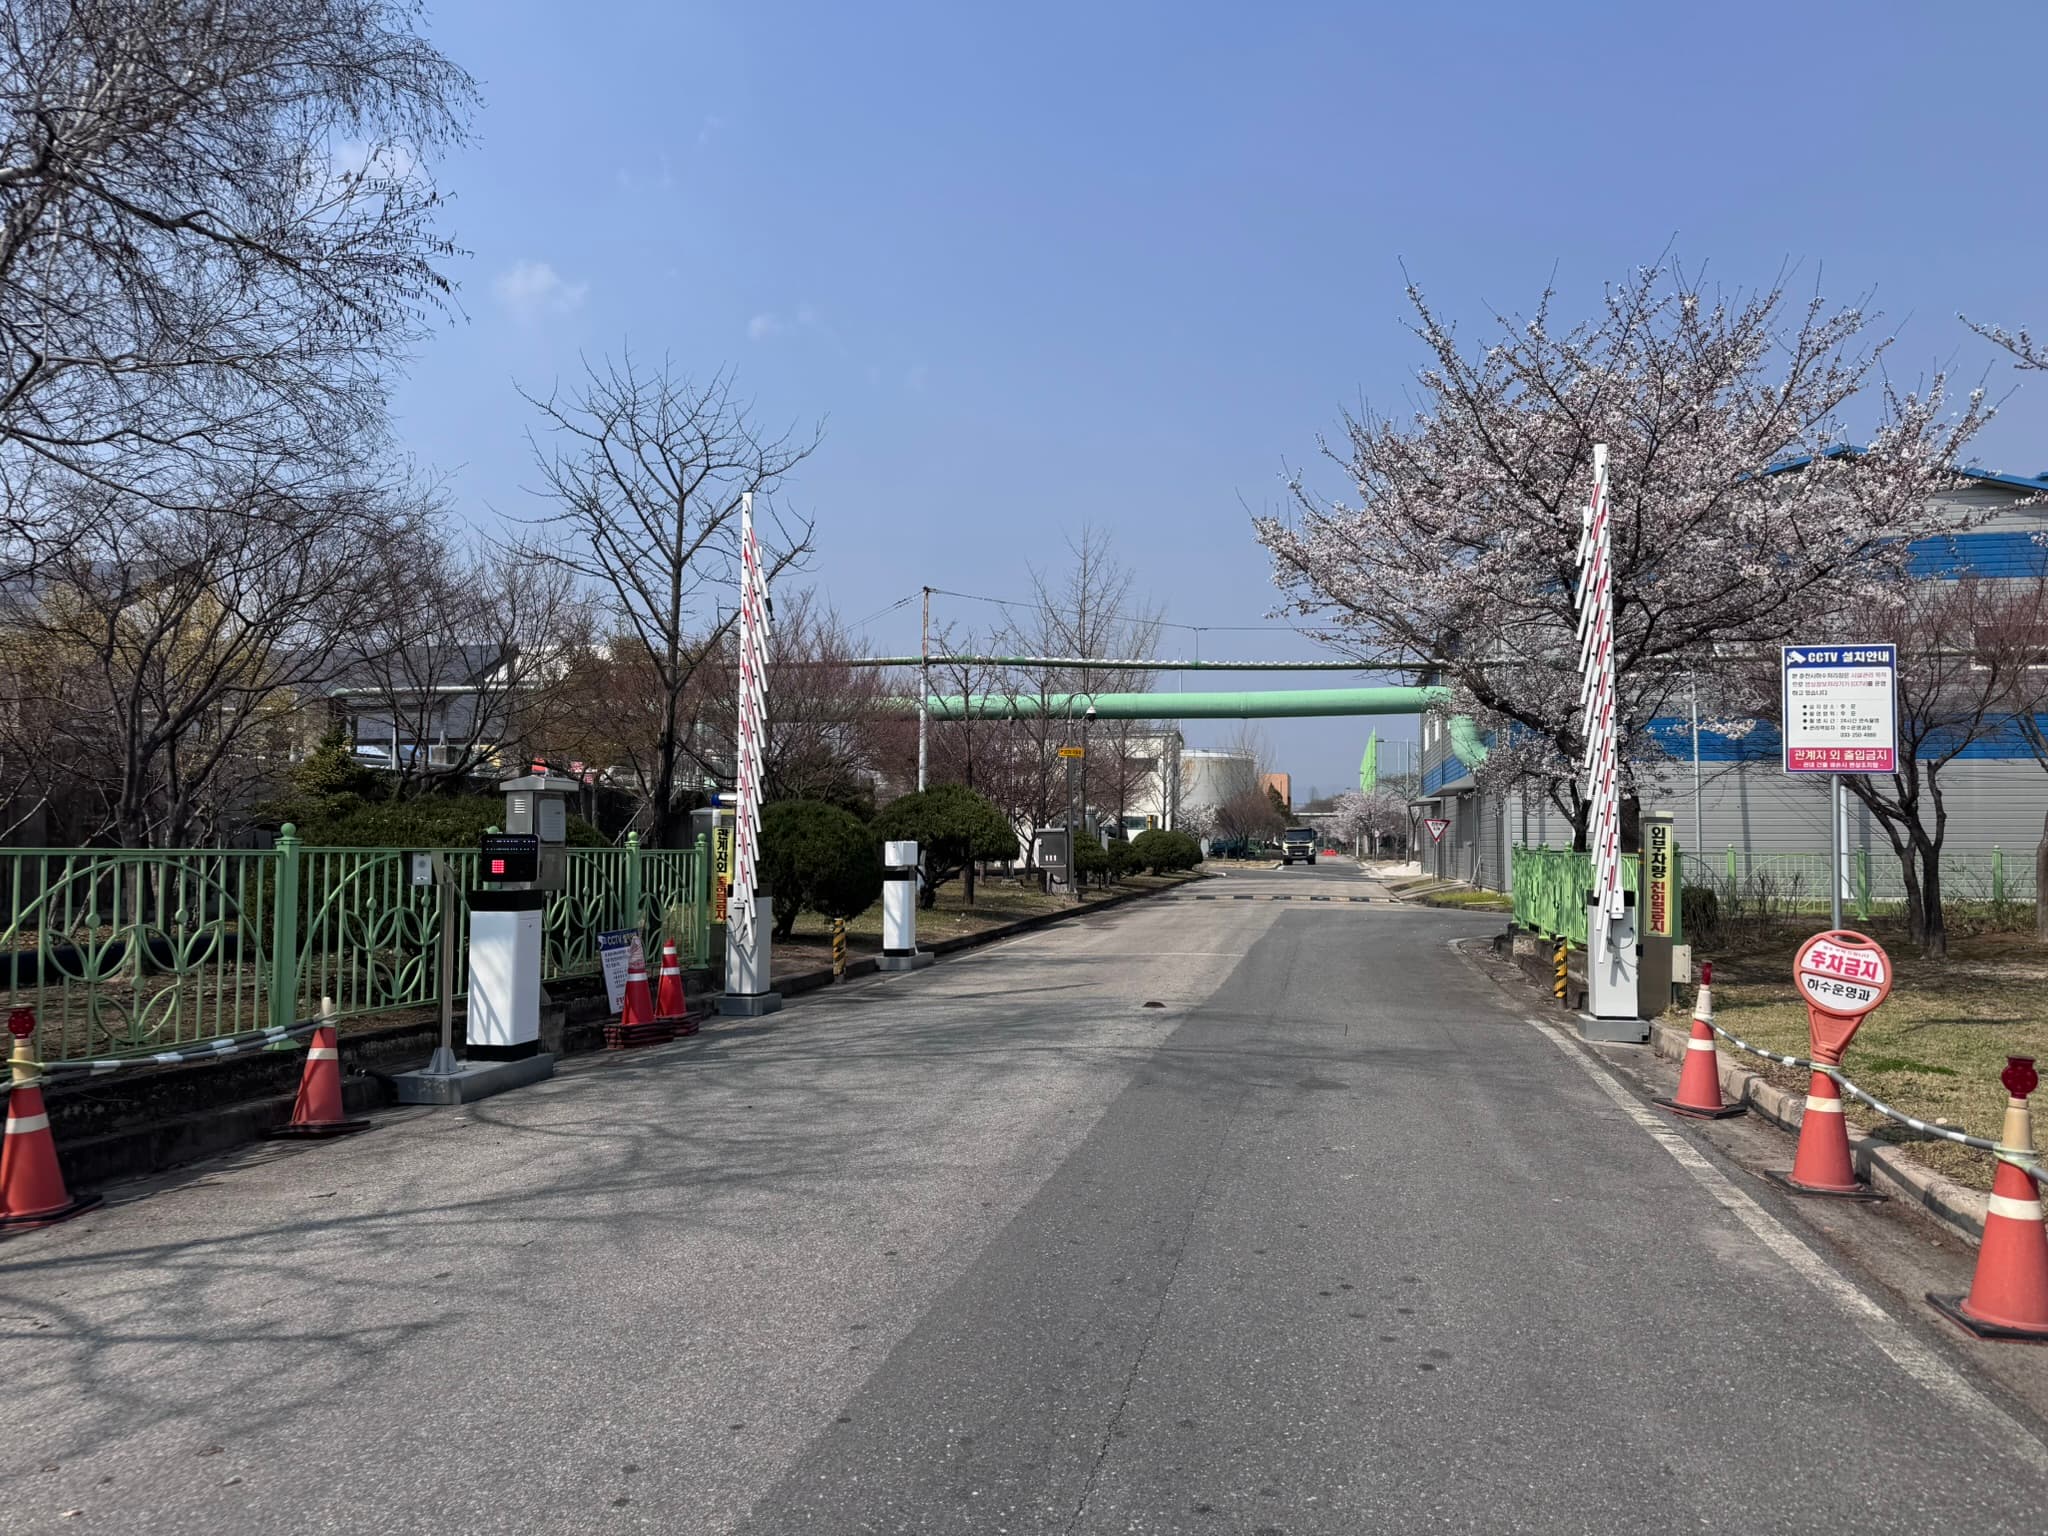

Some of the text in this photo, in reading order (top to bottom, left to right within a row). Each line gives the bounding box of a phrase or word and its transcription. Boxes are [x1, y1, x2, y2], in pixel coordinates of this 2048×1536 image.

[1807, 651, 1889, 662] CCTV 설치안내
[1795, 750, 1887, 760] 관계자 외 출입금지
[716, 829, 729, 873] 관계자외
[1651, 826, 1667, 879] 외부차량
[1650, 881, 1665, 933] 진입금지
[1811, 949, 1878, 980] 주차금지
[1807, 978, 1870, 1001] 하수운영과
